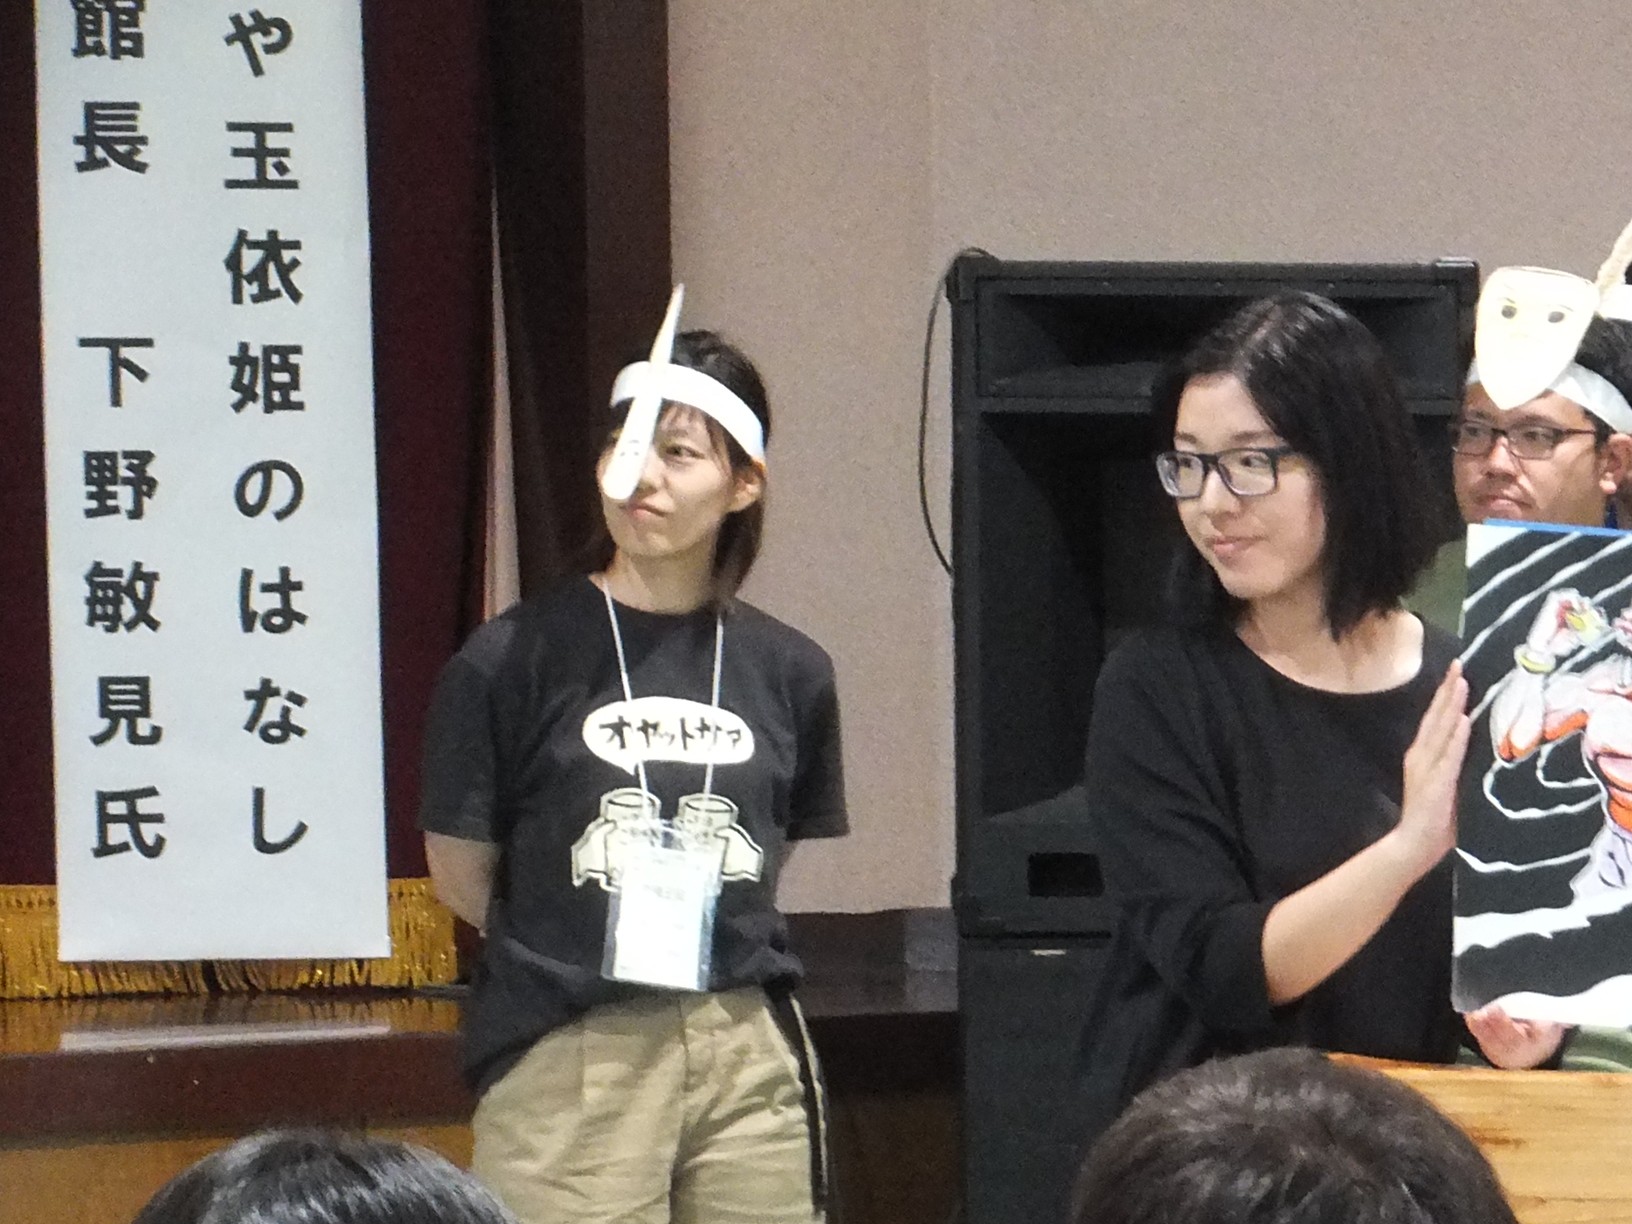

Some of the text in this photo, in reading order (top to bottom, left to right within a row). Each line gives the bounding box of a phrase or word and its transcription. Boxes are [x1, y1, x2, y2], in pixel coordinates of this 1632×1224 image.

[70, 0, 166, 860] 館長 下野敏見氏
[223, 8, 308, 856] や玉依姫のはなし
